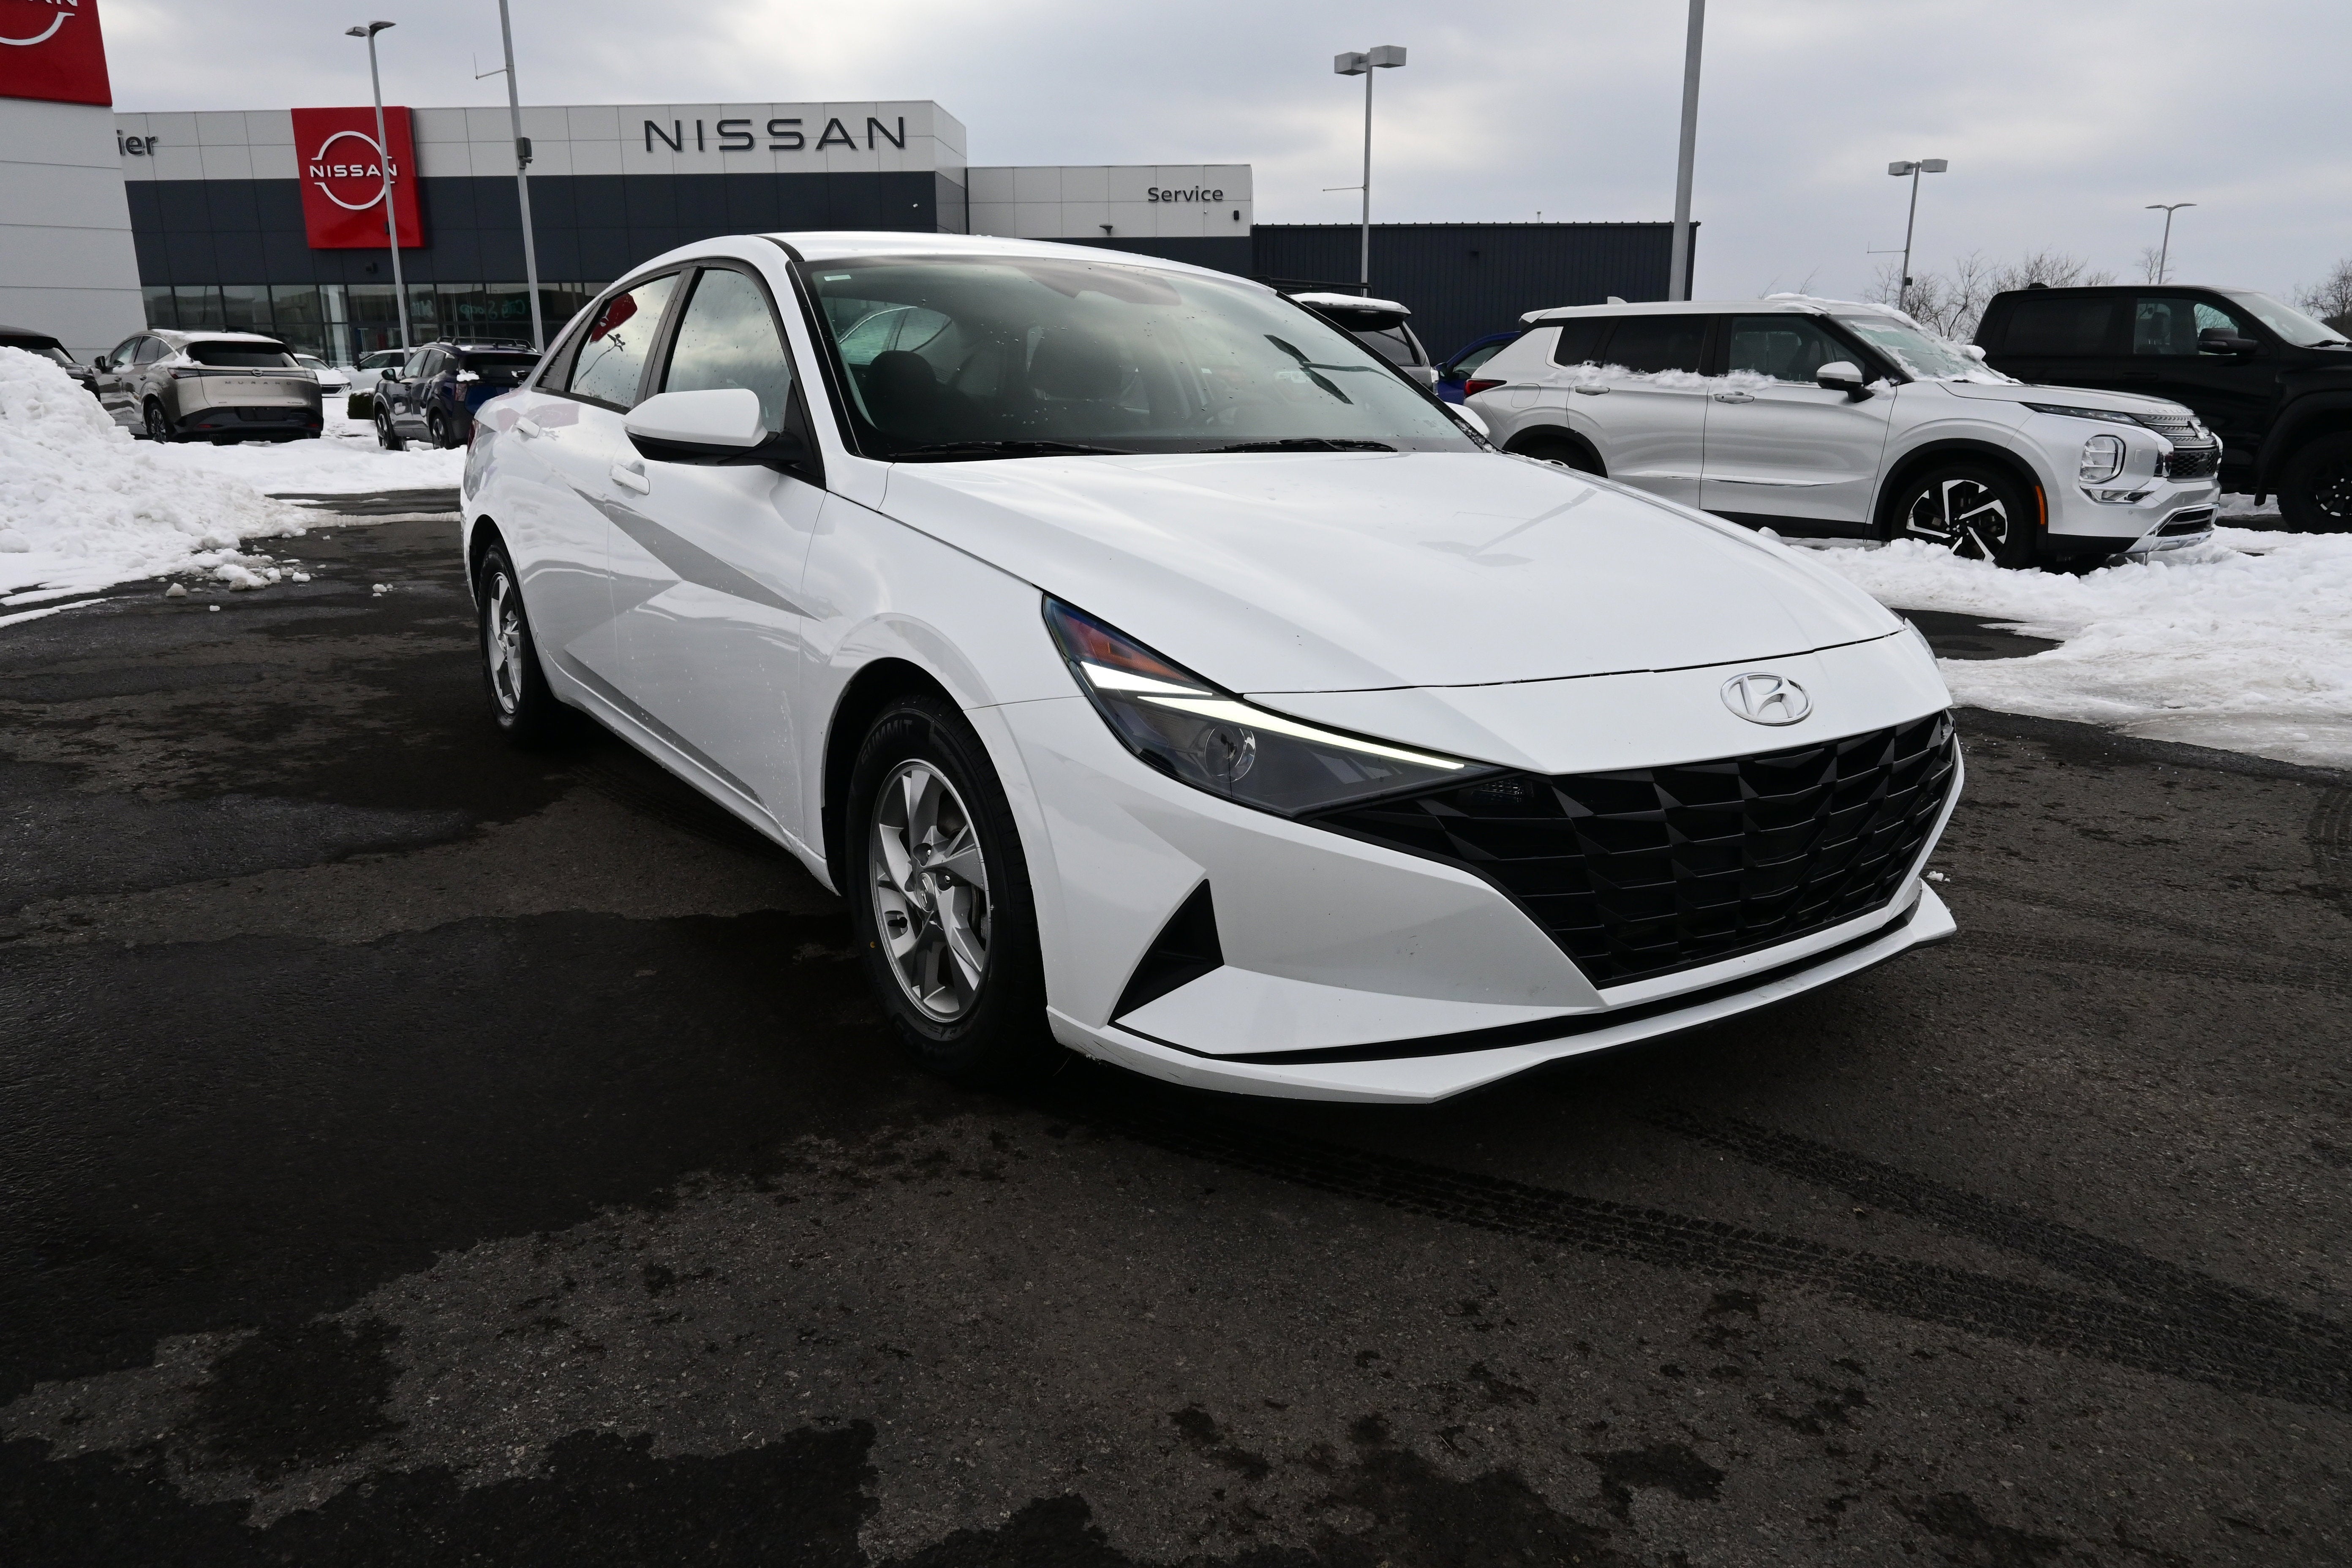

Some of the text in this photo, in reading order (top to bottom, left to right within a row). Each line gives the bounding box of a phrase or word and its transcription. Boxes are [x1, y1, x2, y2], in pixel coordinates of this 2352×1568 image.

[644, 117, 906, 152] NISSAN
[310, 164, 397, 177] NISSAN
[1148, 185, 1223, 202] Service
[861, 720, 912, 765] SUMMIT
